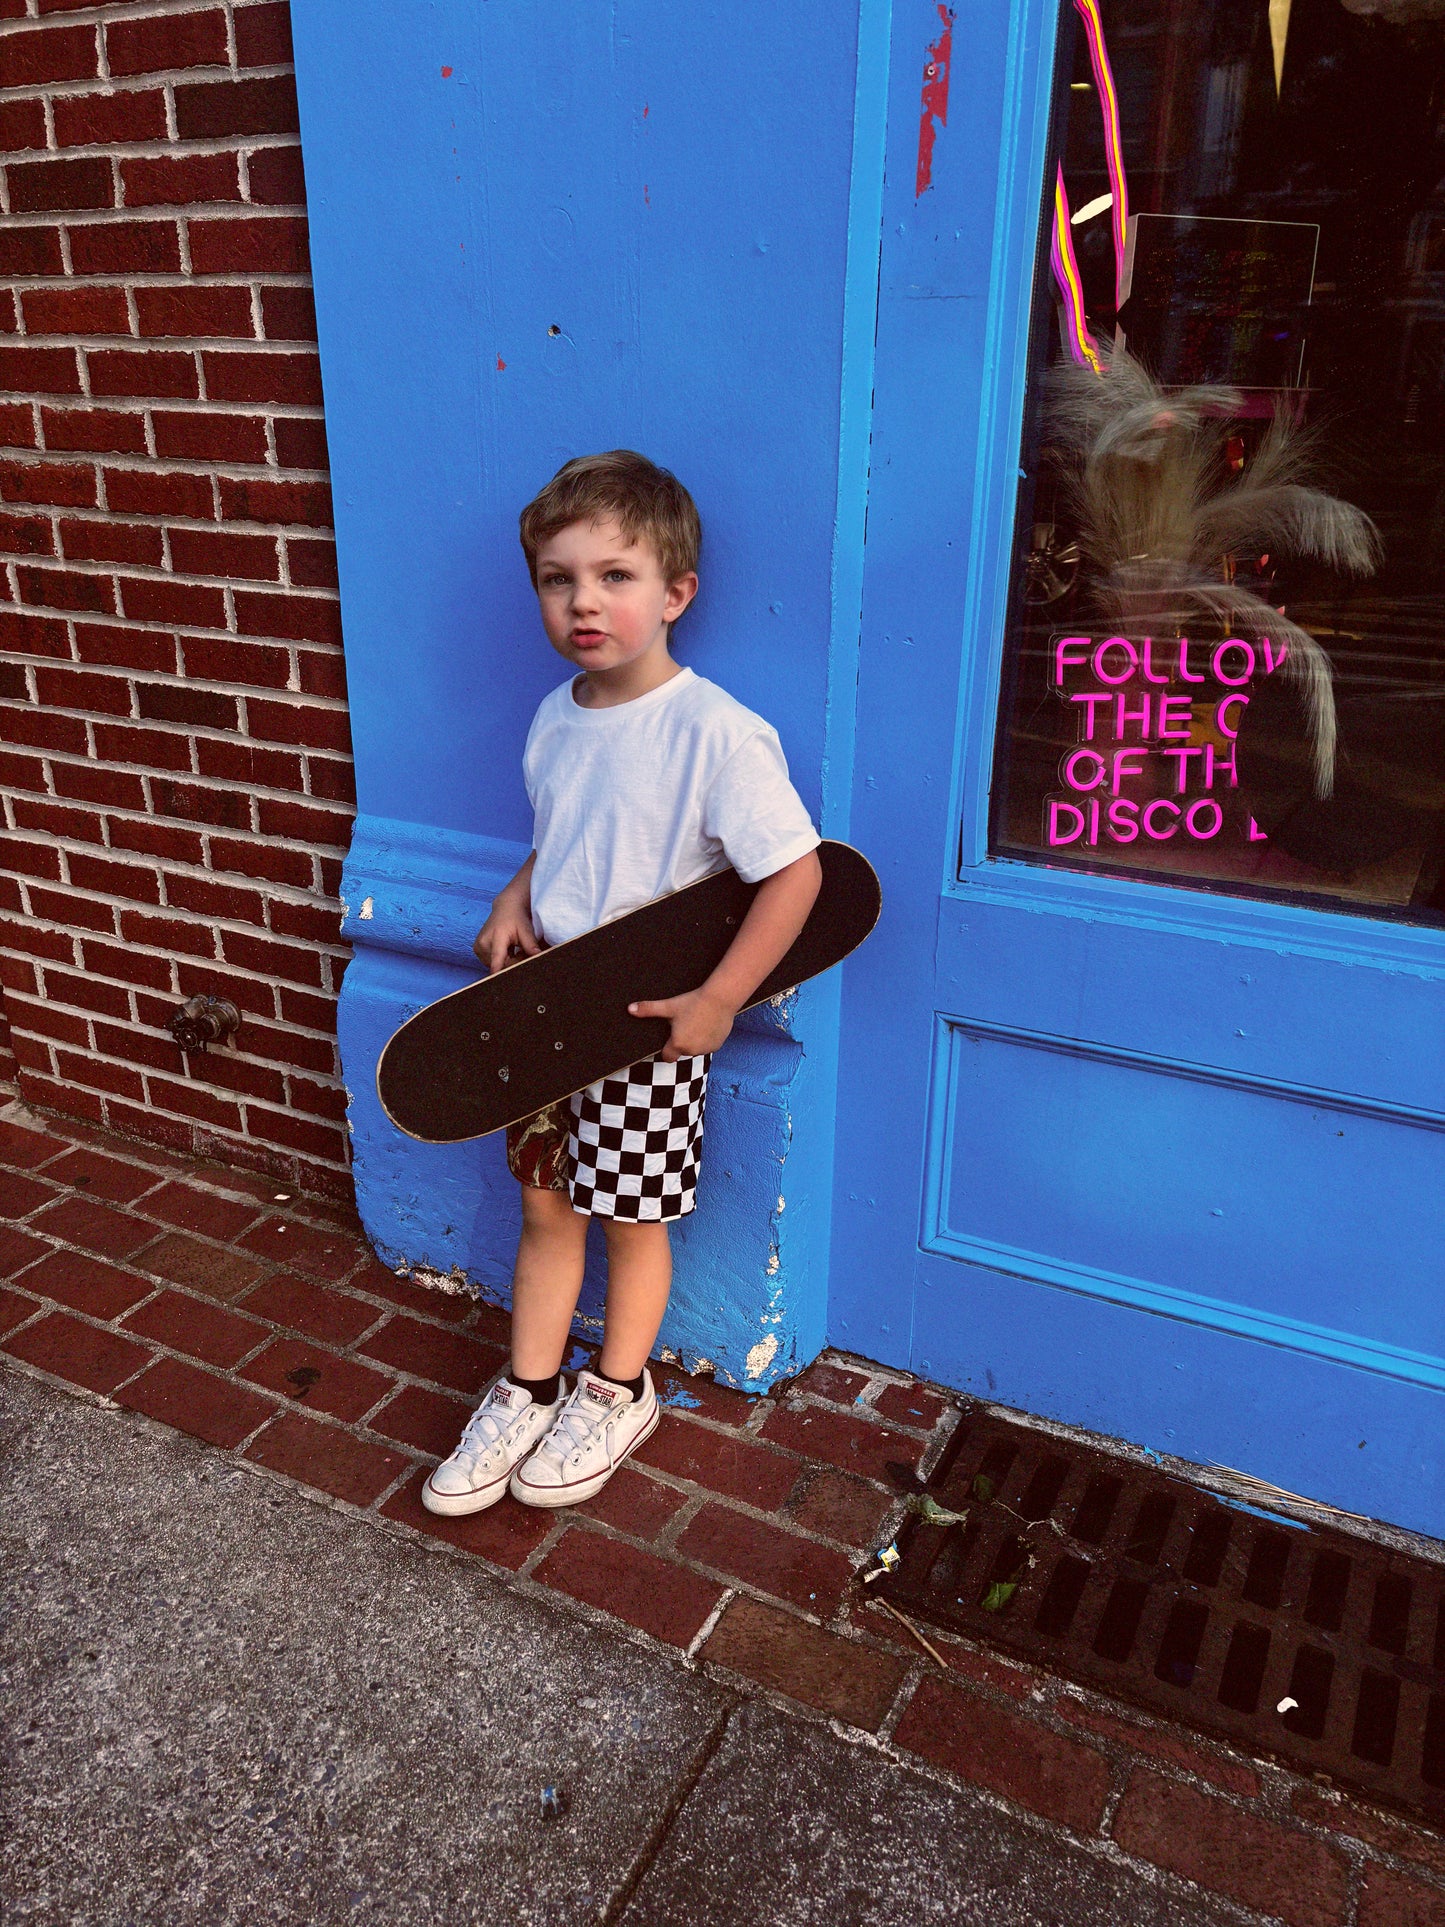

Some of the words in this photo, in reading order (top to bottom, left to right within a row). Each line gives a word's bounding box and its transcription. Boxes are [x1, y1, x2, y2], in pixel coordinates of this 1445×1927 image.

[1070, 693, 1192, 740] THE
[1066, 748, 1149, 797] OF
[1049, 798, 1223, 846] DISCO
